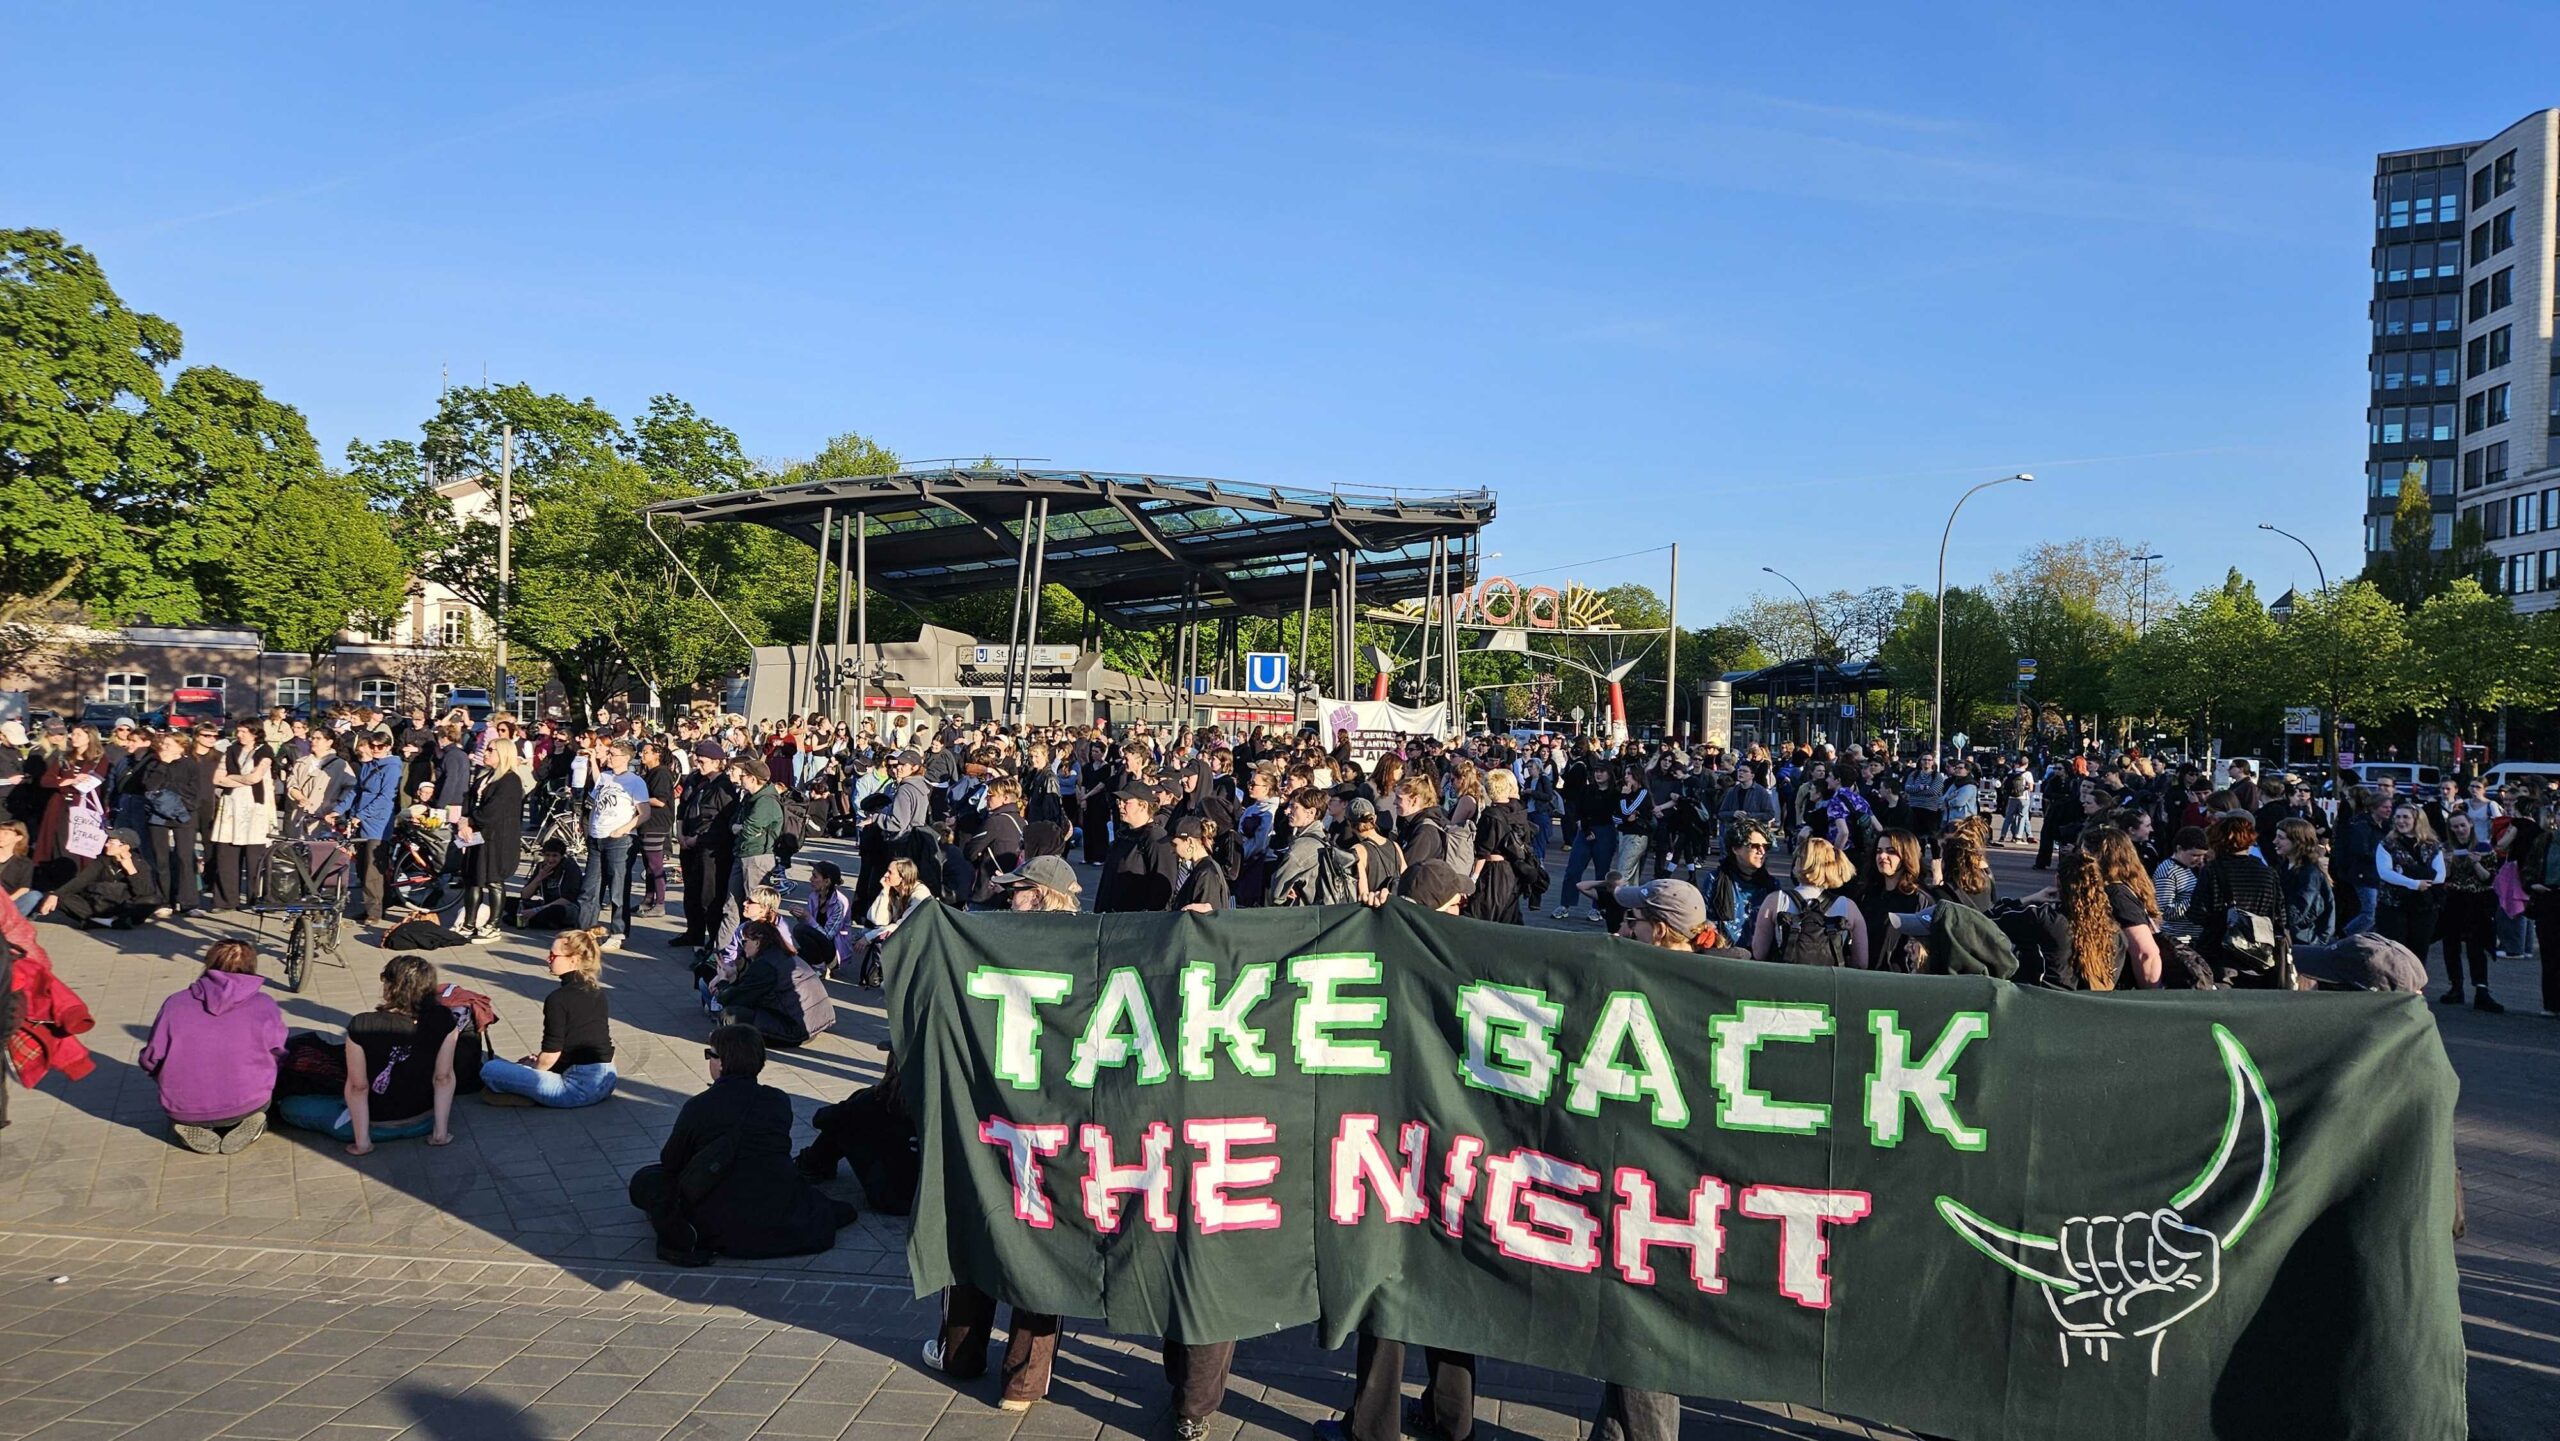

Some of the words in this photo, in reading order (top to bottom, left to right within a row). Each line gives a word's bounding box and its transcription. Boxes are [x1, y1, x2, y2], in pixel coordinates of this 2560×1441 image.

[996, 649, 1007, 658] St.
[1253, 657, 1282, 690] U
[1844, 706, 1854, 716] U
[966, 952, 1391, 1090] TAKE
[1456, 979, 1989, 1151] BACK
[979, 1114, 1281, 1235] THE
[1330, 1113, 1871, 1309] NIGHT
